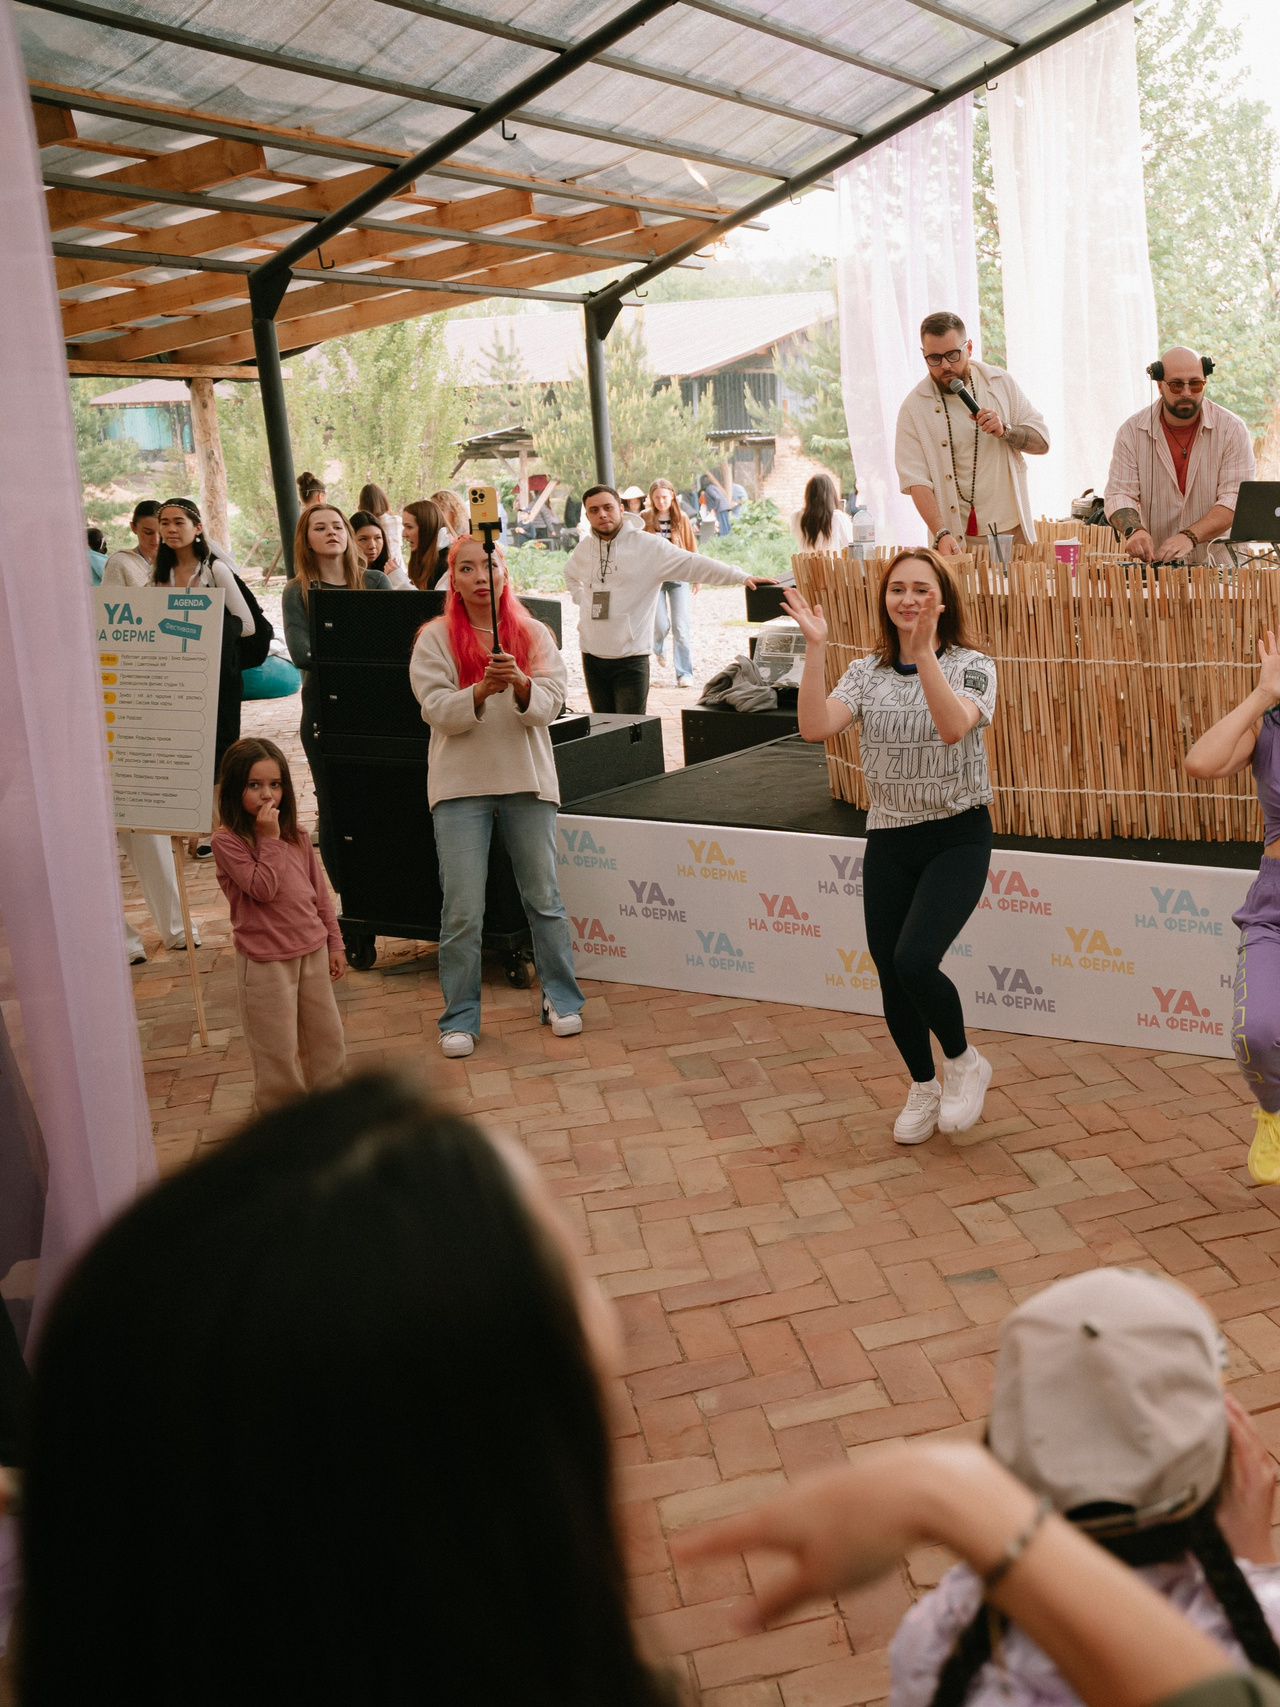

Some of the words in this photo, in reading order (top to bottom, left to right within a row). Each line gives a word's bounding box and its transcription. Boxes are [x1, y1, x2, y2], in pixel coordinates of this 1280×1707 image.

[104, 603, 143, 625] YA.
[97, 629, 107, 641] А
[112, 629, 155, 642] ФЕРМЕ
[559, 828, 605, 855] YA.
[687, 838, 735, 866] YA.
[572, 854, 617, 870] ФЕРМЕ
[677, 864, 696, 878] НА
[700, 866, 748, 883] ФЕРМЕ
[829, 854, 865, 880] YA
[628, 880, 675, 906] YA.
[818, 881, 838, 895] НА
[988, 869, 1038, 898] YA.
[619, 903, 638, 918] НА
[642, 906, 687, 923] ФЕРМЕ
[759, 892, 809, 920] YA.
[997, 898, 1052, 916] ФЕРМЕ
[1151, 887, 1209, 917] YA.
[570, 916, 615, 942] YA.
[748, 918, 768, 932] НА
[773, 919, 821, 937] ФЕРМЕ
[1134, 913, 1159, 930] НА
[1165, 916, 1223, 937] ФЕРМЕ
[571, 940, 580, 951] А
[582, 942, 627, 959] ФЕРМЕ
[695, 930, 743, 957] YA.
[1066, 927, 1122, 957] YA.
[686, 954, 705, 969] НА
[708, 956, 756, 974] ФЕРМЕ
[836, 948, 878, 976] YA
[1051, 953, 1073, 968] НА
[1079, 955, 1134, 975] ФЕРМЕ
[825, 973, 845, 988] НА
[848, 975, 881, 992] ФЕР
[988, 965, 1043, 995] YA.
[1220, 974, 1234, 988] Н
[976, 991, 998, 1006] НА
[1002, 993, 1056, 1013] ФЕРМЕ
[1152, 987, 1210, 1017] YA.
[1138, 1013, 1160, 1029] НА
[1166, 1016, 1223, 1036] ФЕРМЕ
